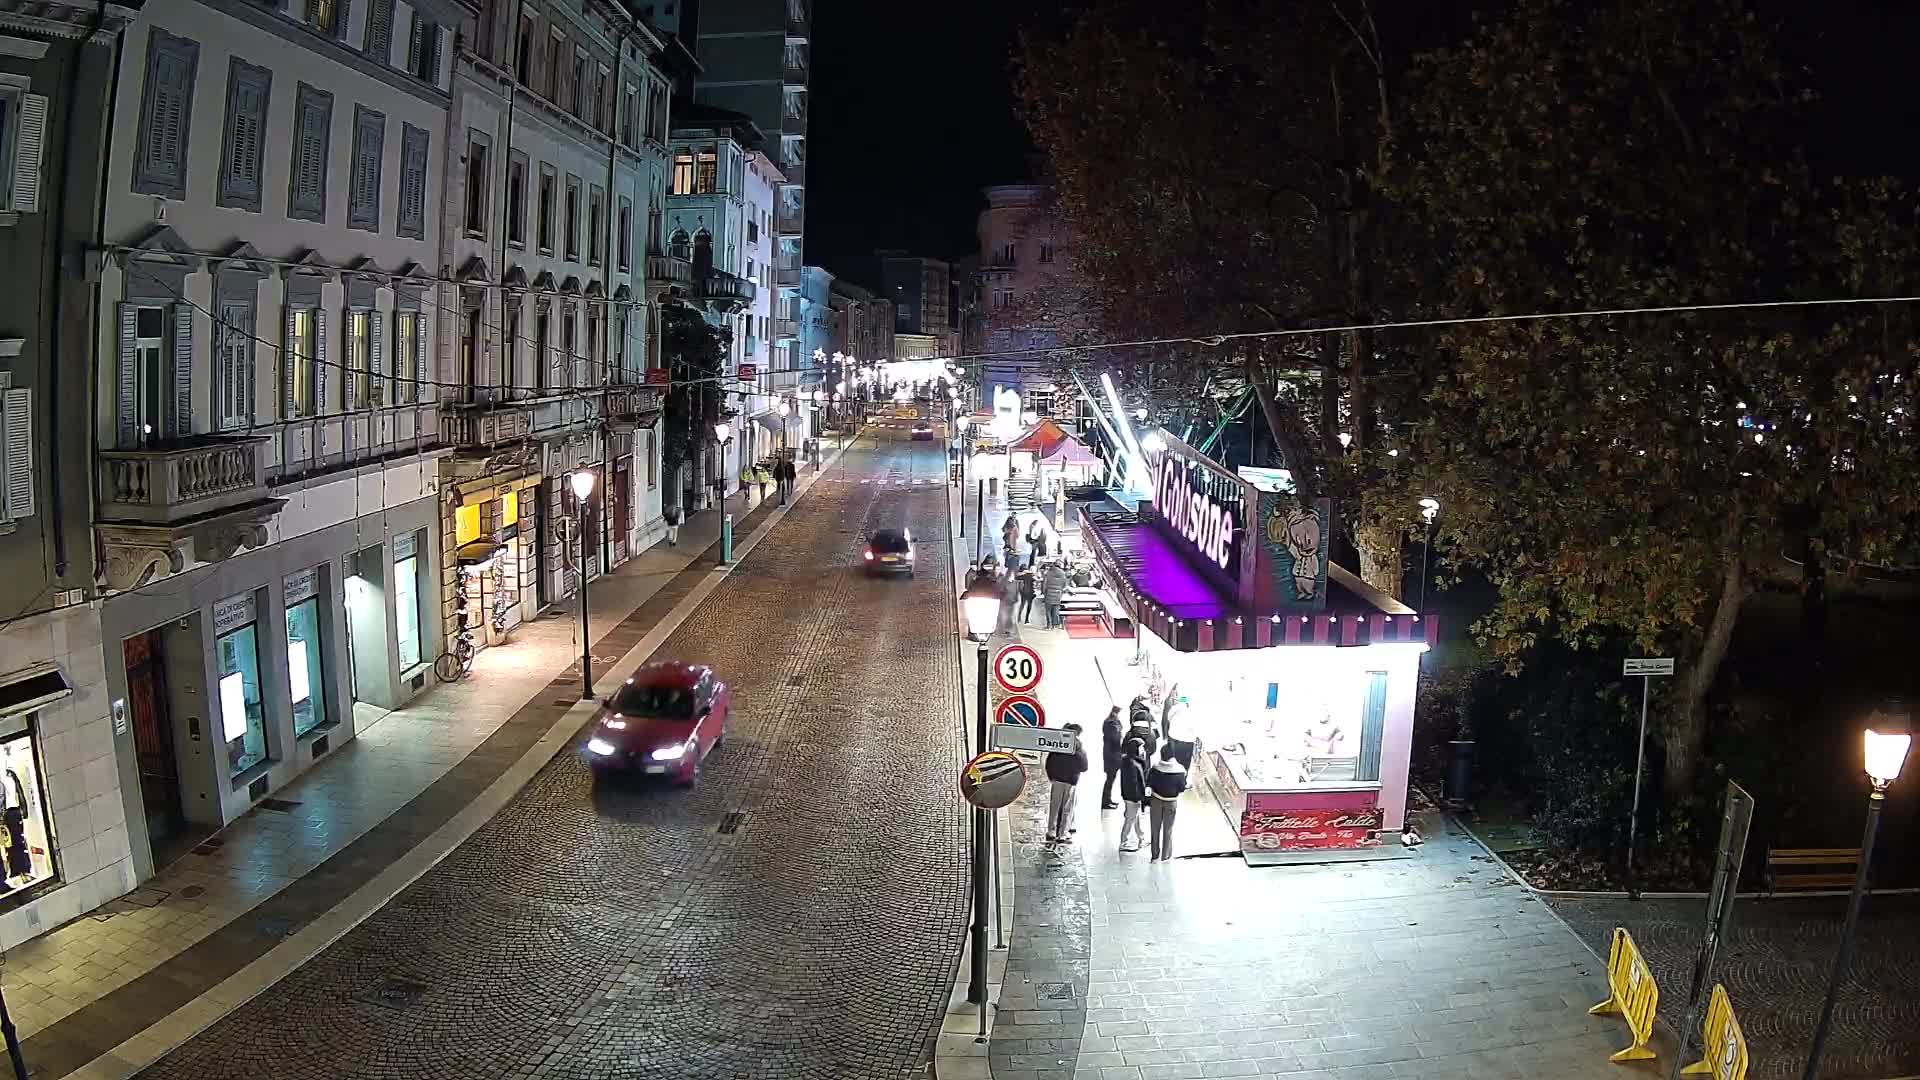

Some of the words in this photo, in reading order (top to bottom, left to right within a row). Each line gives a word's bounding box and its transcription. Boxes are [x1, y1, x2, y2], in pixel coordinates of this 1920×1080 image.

[1162, 458, 1233, 569] Golosone
[1006, 658, 1032, 679] 30
[1038, 737, 1069, 749] Dante
